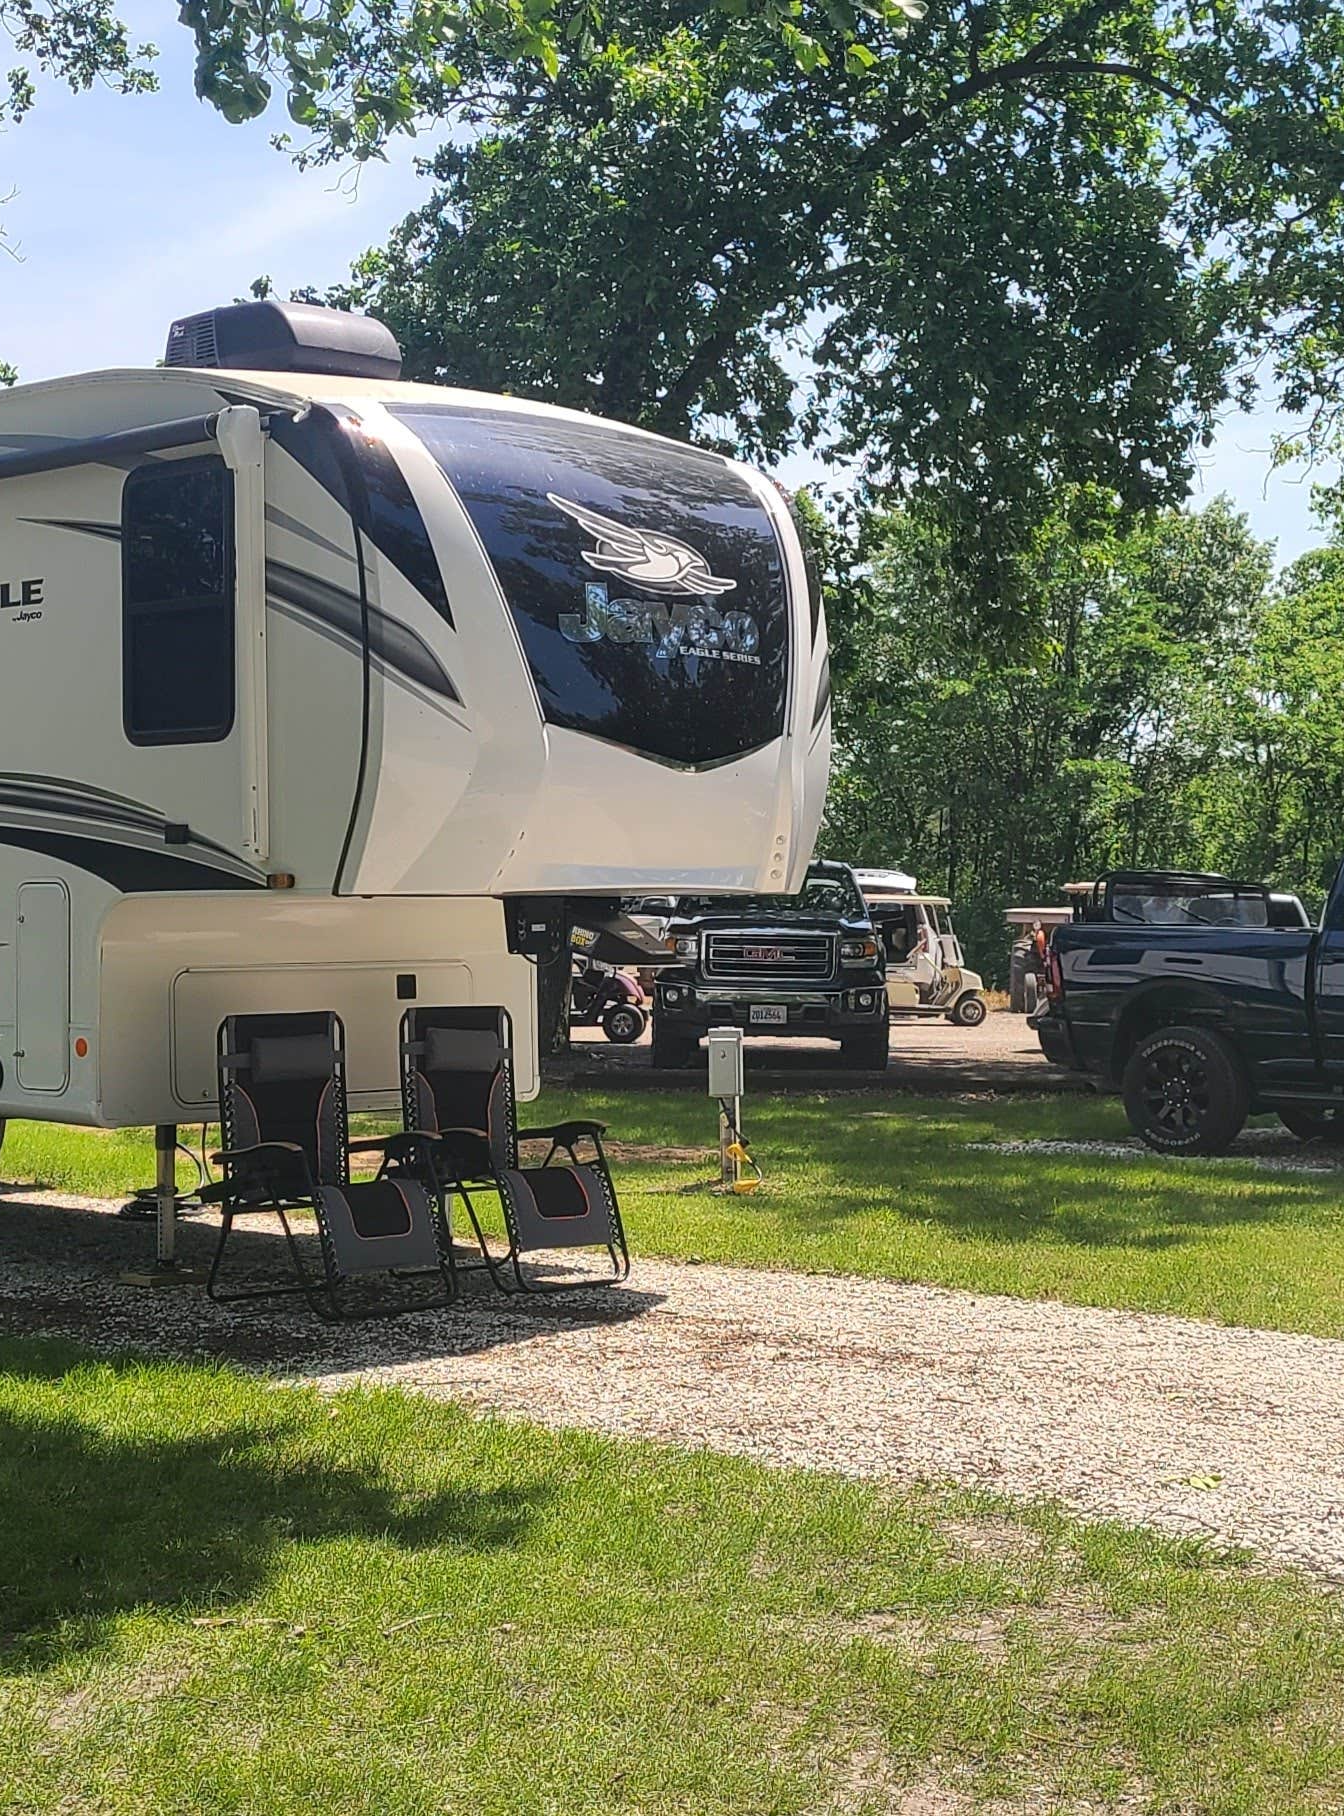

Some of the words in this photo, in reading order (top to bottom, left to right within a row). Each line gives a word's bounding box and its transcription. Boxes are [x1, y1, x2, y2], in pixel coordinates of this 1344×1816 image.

[558, 582, 760, 659] Jayco
[679, 646, 721, 659] EAGLE
[721, 651, 762, 666] SERIES
[570, 934, 586, 947] BOX
[571, 925, 595, 941] RHINO
[744, 946, 796, 961] GMC
